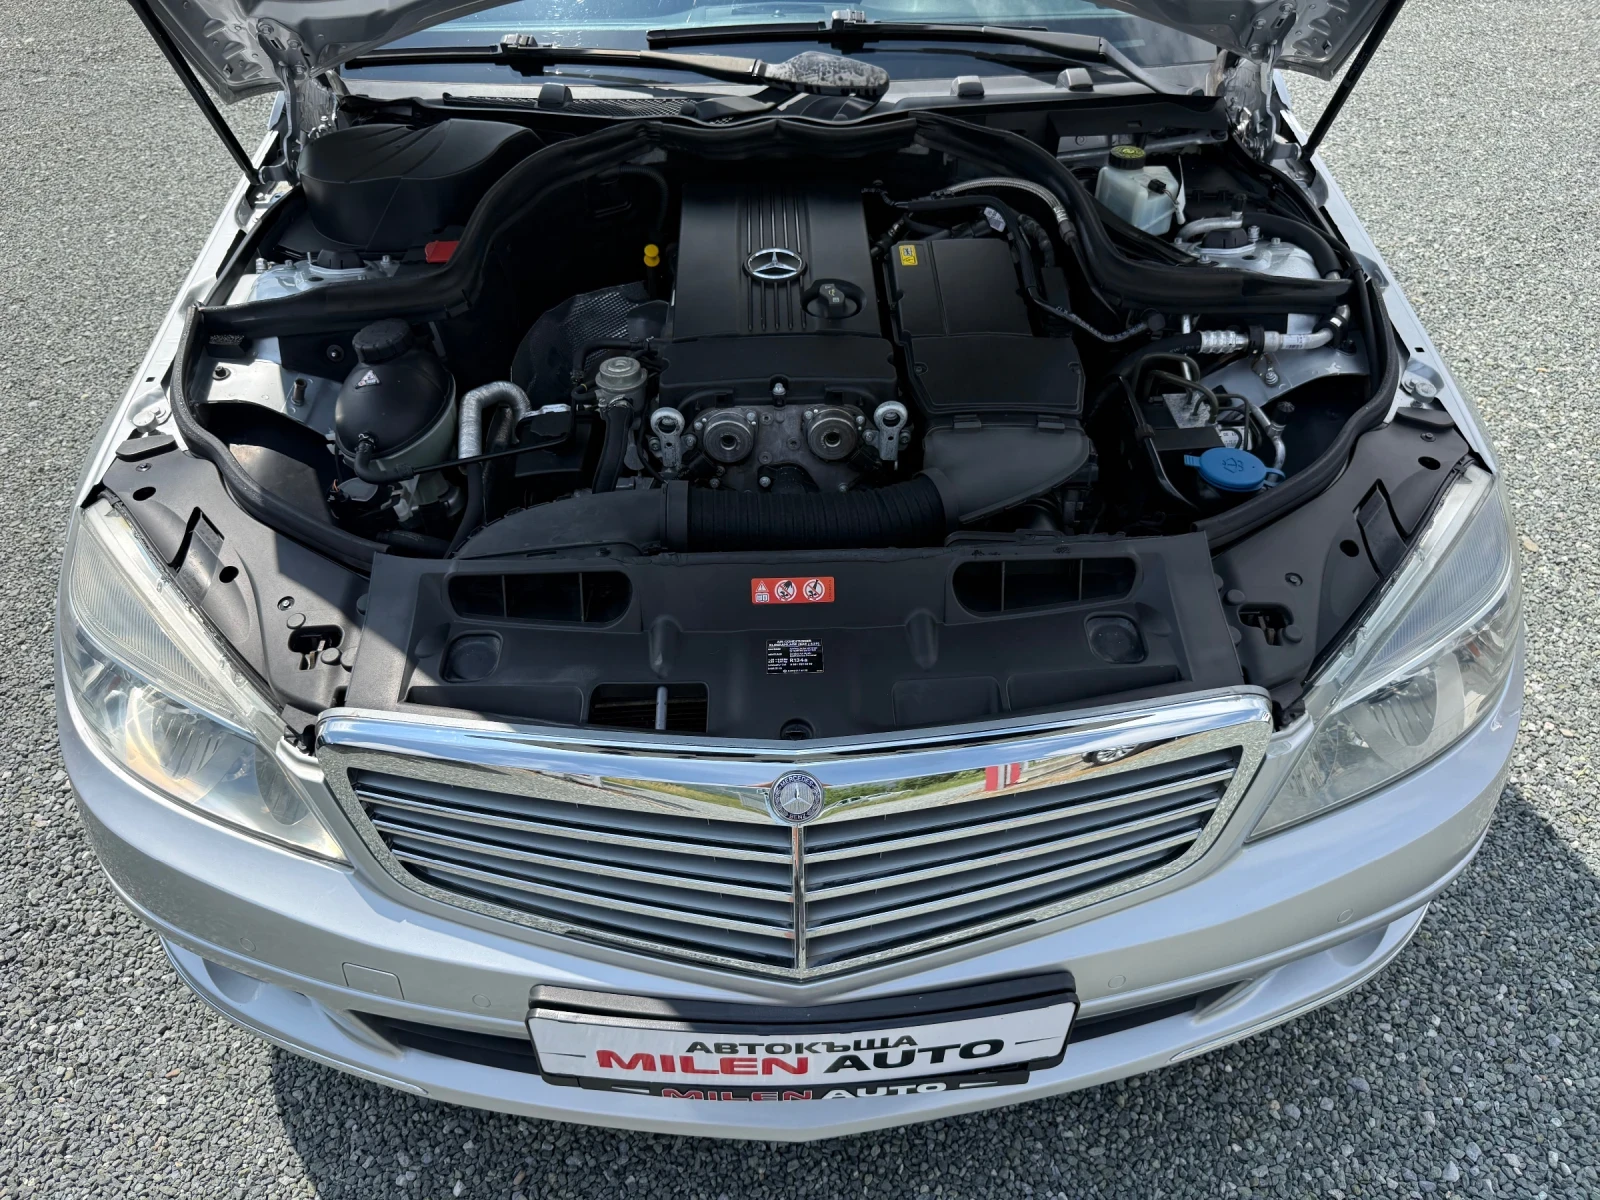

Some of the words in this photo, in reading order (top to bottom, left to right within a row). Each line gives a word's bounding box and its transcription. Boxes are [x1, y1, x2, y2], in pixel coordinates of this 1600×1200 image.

[780, 775, 814, 787] MERCEDES
[596, 1049, 808, 1075] MILEN
[823, 1038, 1005, 1074] AUTO
[661, 1088, 812, 1101] MILEN
[822, 1082, 946, 1100] AUTO
